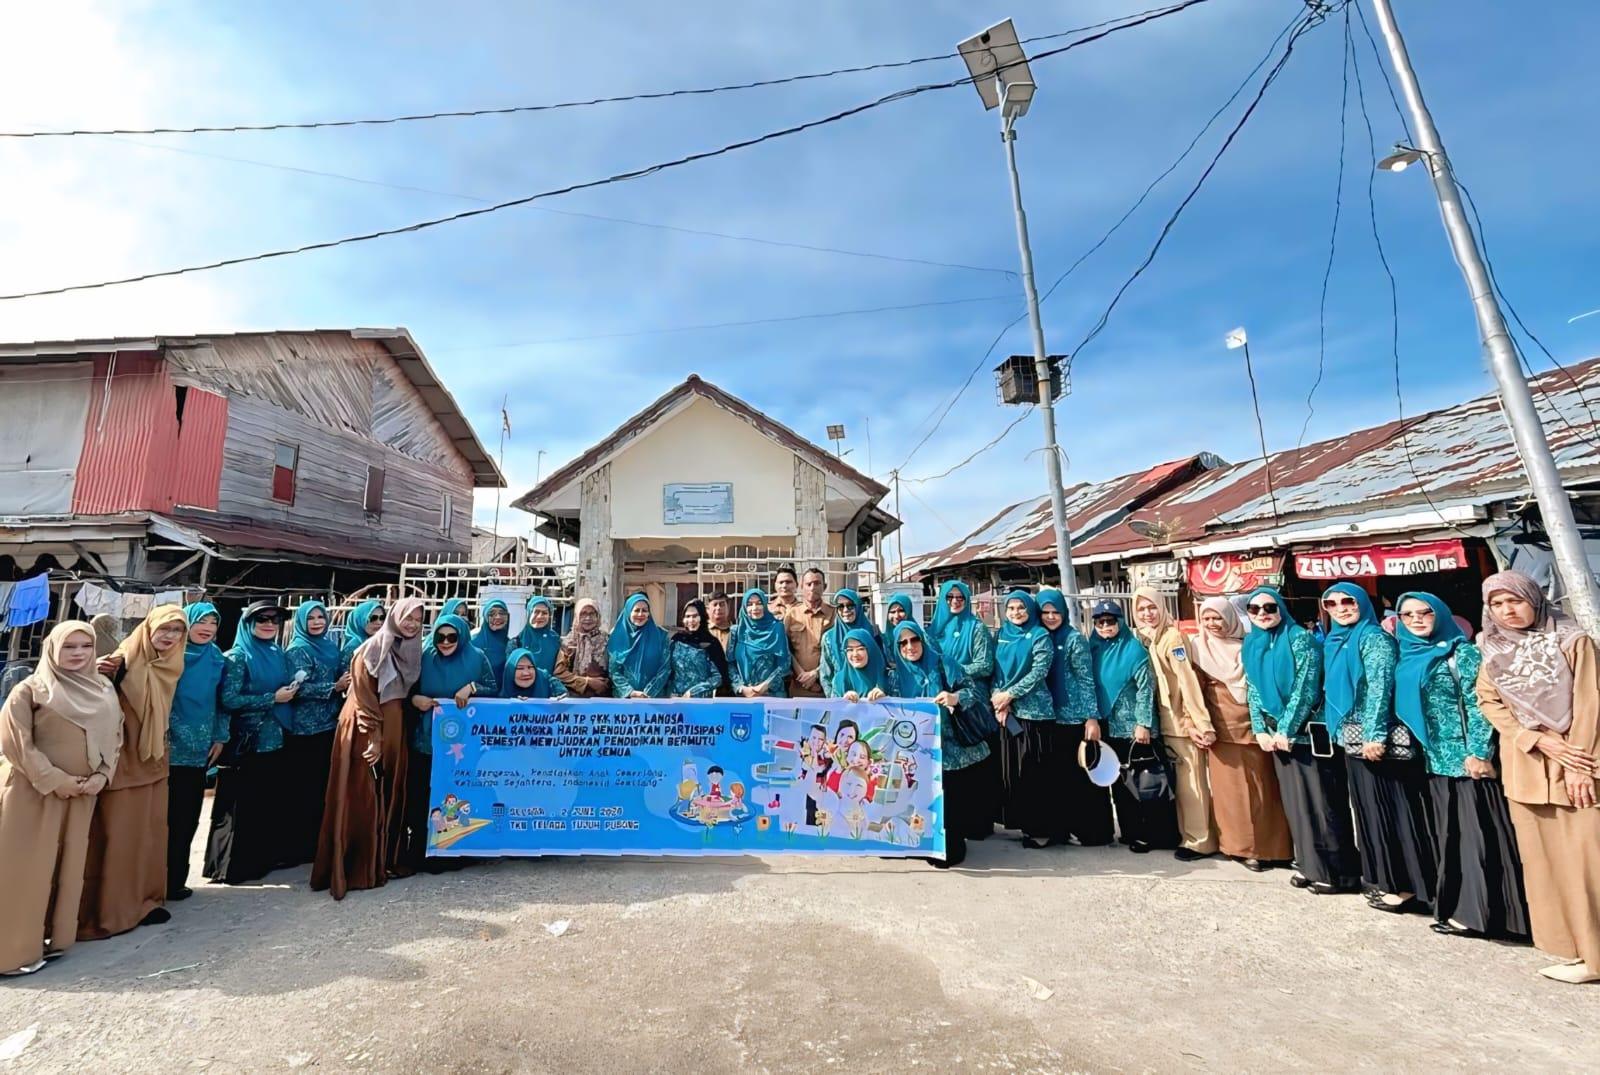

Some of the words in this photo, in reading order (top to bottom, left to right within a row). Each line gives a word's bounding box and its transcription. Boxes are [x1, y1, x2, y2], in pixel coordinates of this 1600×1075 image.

[1298, 555, 1377, 576] ZENGA
[509, 713, 569, 724] KUNJUNGAN
[573, 713, 586, 724] TP
[590, 713, 610, 725] PKK
[614, 713, 640, 724] KOTA
[644, 712, 684, 724] LANGSA
[471, 724, 507, 736] DALAM
[511, 724, 553, 736] RANGKA
[557, 724, 588, 736] HADIR
[592, 724, 660, 736] MENGUATKAN
[664, 724, 724, 736] PARTISIPASI
[480, 736, 526, 747] SEMESTA
[530, 736, 600, 747] MEWUJUDKAN
[604, 735, 663, 747] PENDIDIKAN
[667, 735, 716, 746] BERMUTU
[559, 747, 592, 758] UNTUK
[598, 747, 631, 758] SEMUA
